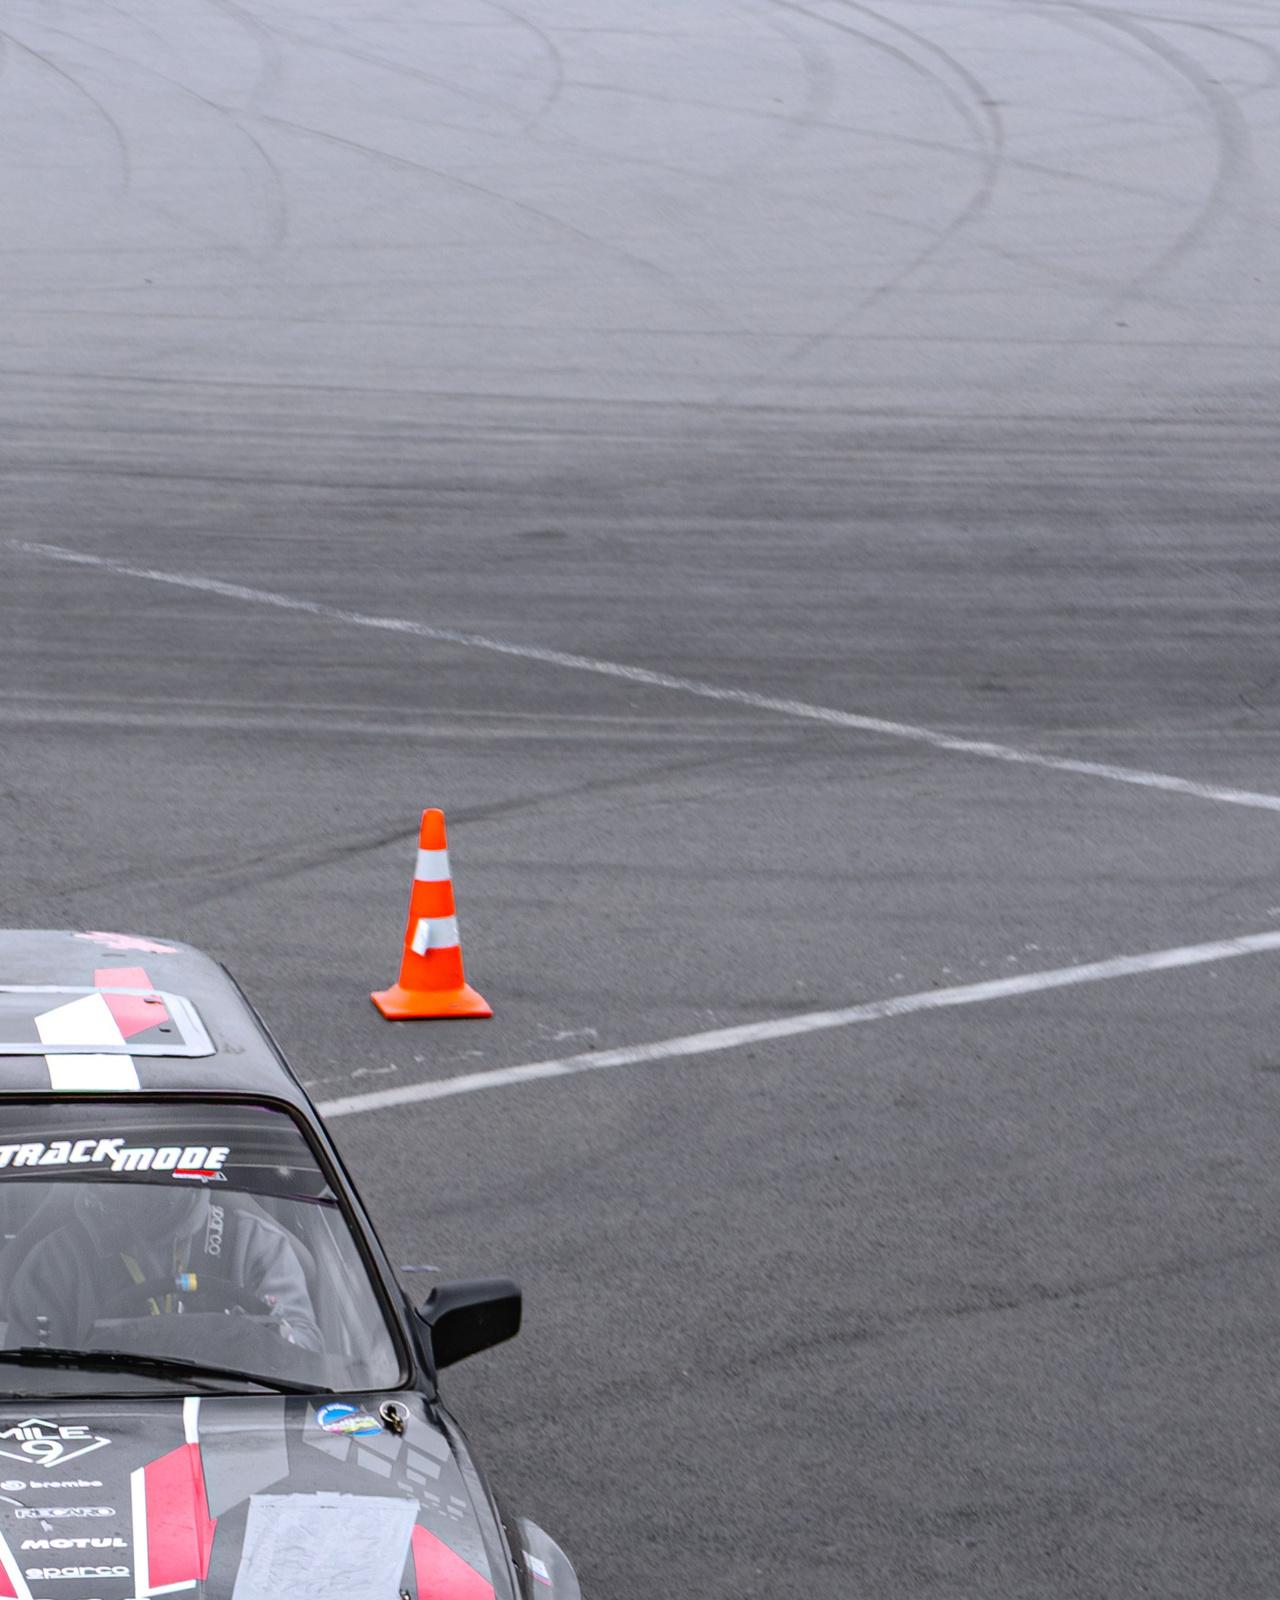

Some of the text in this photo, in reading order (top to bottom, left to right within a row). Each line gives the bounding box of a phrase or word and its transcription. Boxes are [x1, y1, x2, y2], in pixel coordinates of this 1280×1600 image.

[21, 1439, 64, 1464] 9
[29, 1479, 103, 1489] brembo
[20, 1537, 128, 1550] MOTUL
